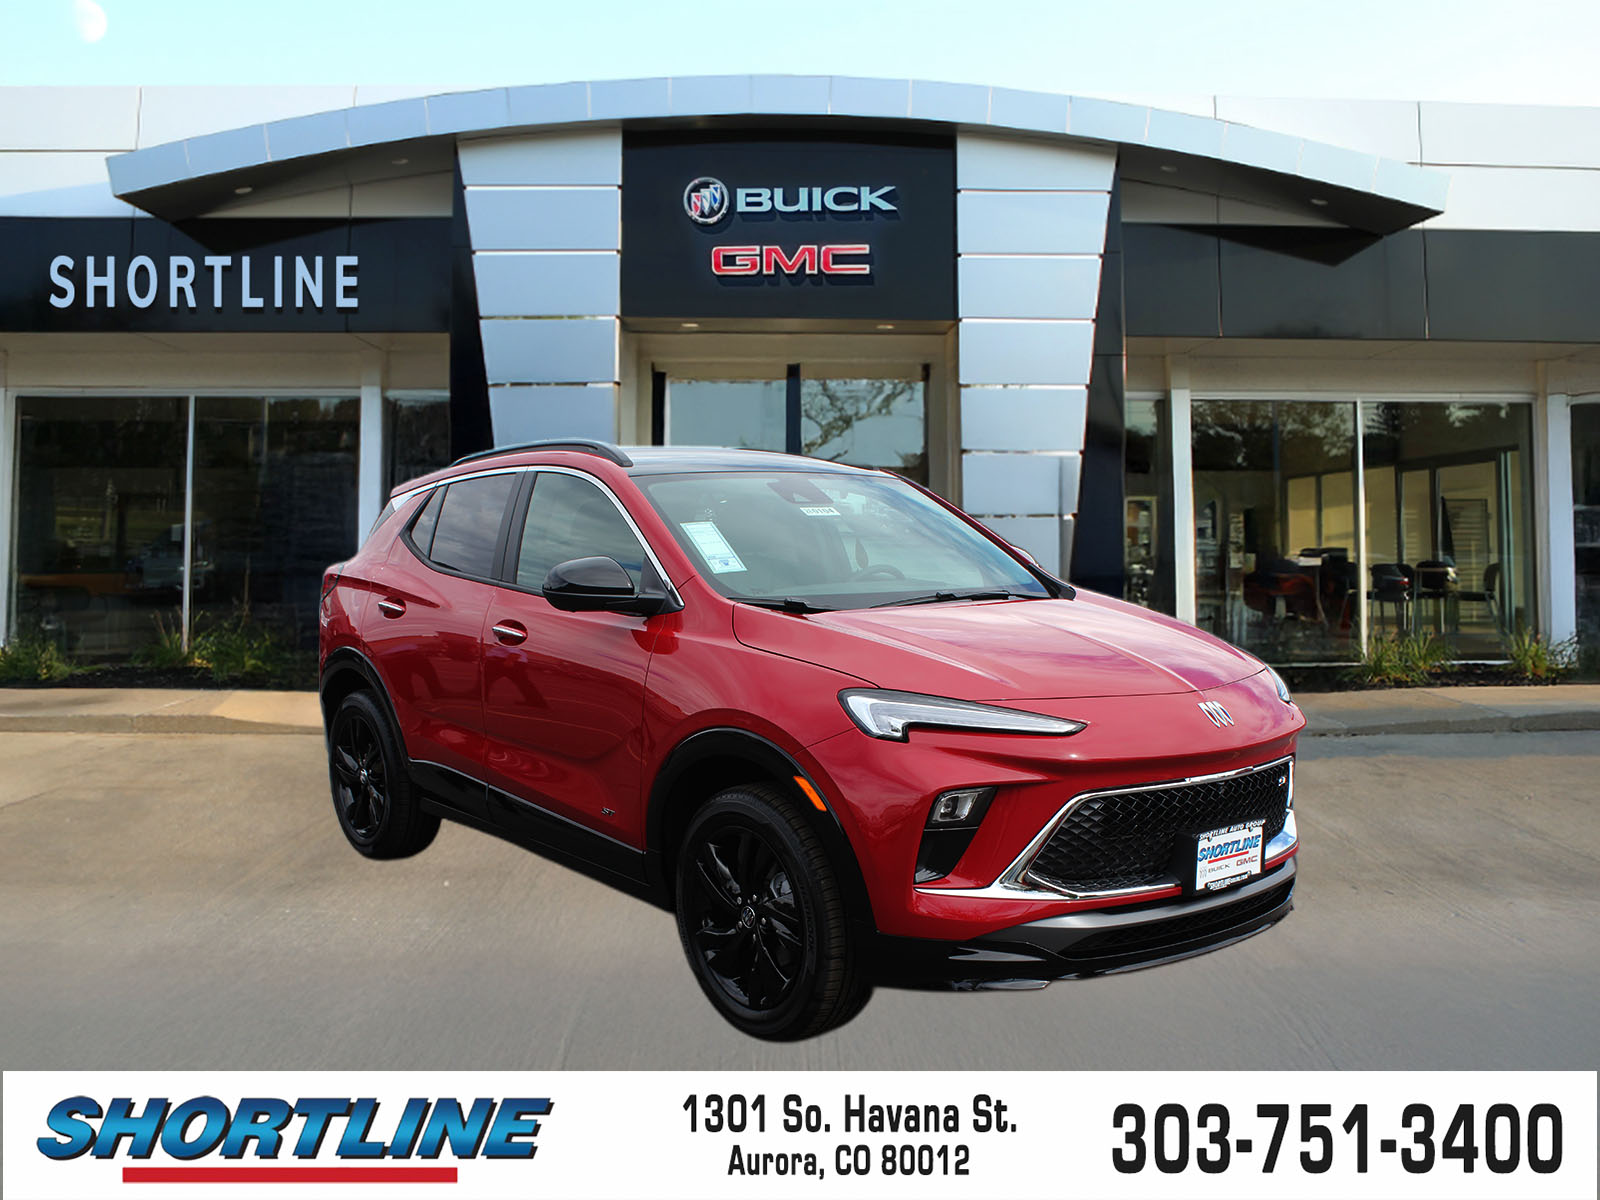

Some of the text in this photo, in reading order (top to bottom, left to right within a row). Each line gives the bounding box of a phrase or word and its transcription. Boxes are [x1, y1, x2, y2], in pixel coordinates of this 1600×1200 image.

[737, 186, 898, 212] BUICK
[711, 244, 870, 275] GMC
[49, 255, 360, 309] SHORTLINE
[1229, 823, 1244, 833] AUTO
[1198, 834, 1262, 862] SHORTLINE
[1235, 855, 1258, 867] GMC
[1208, 863, 1231, 874] BUICK
